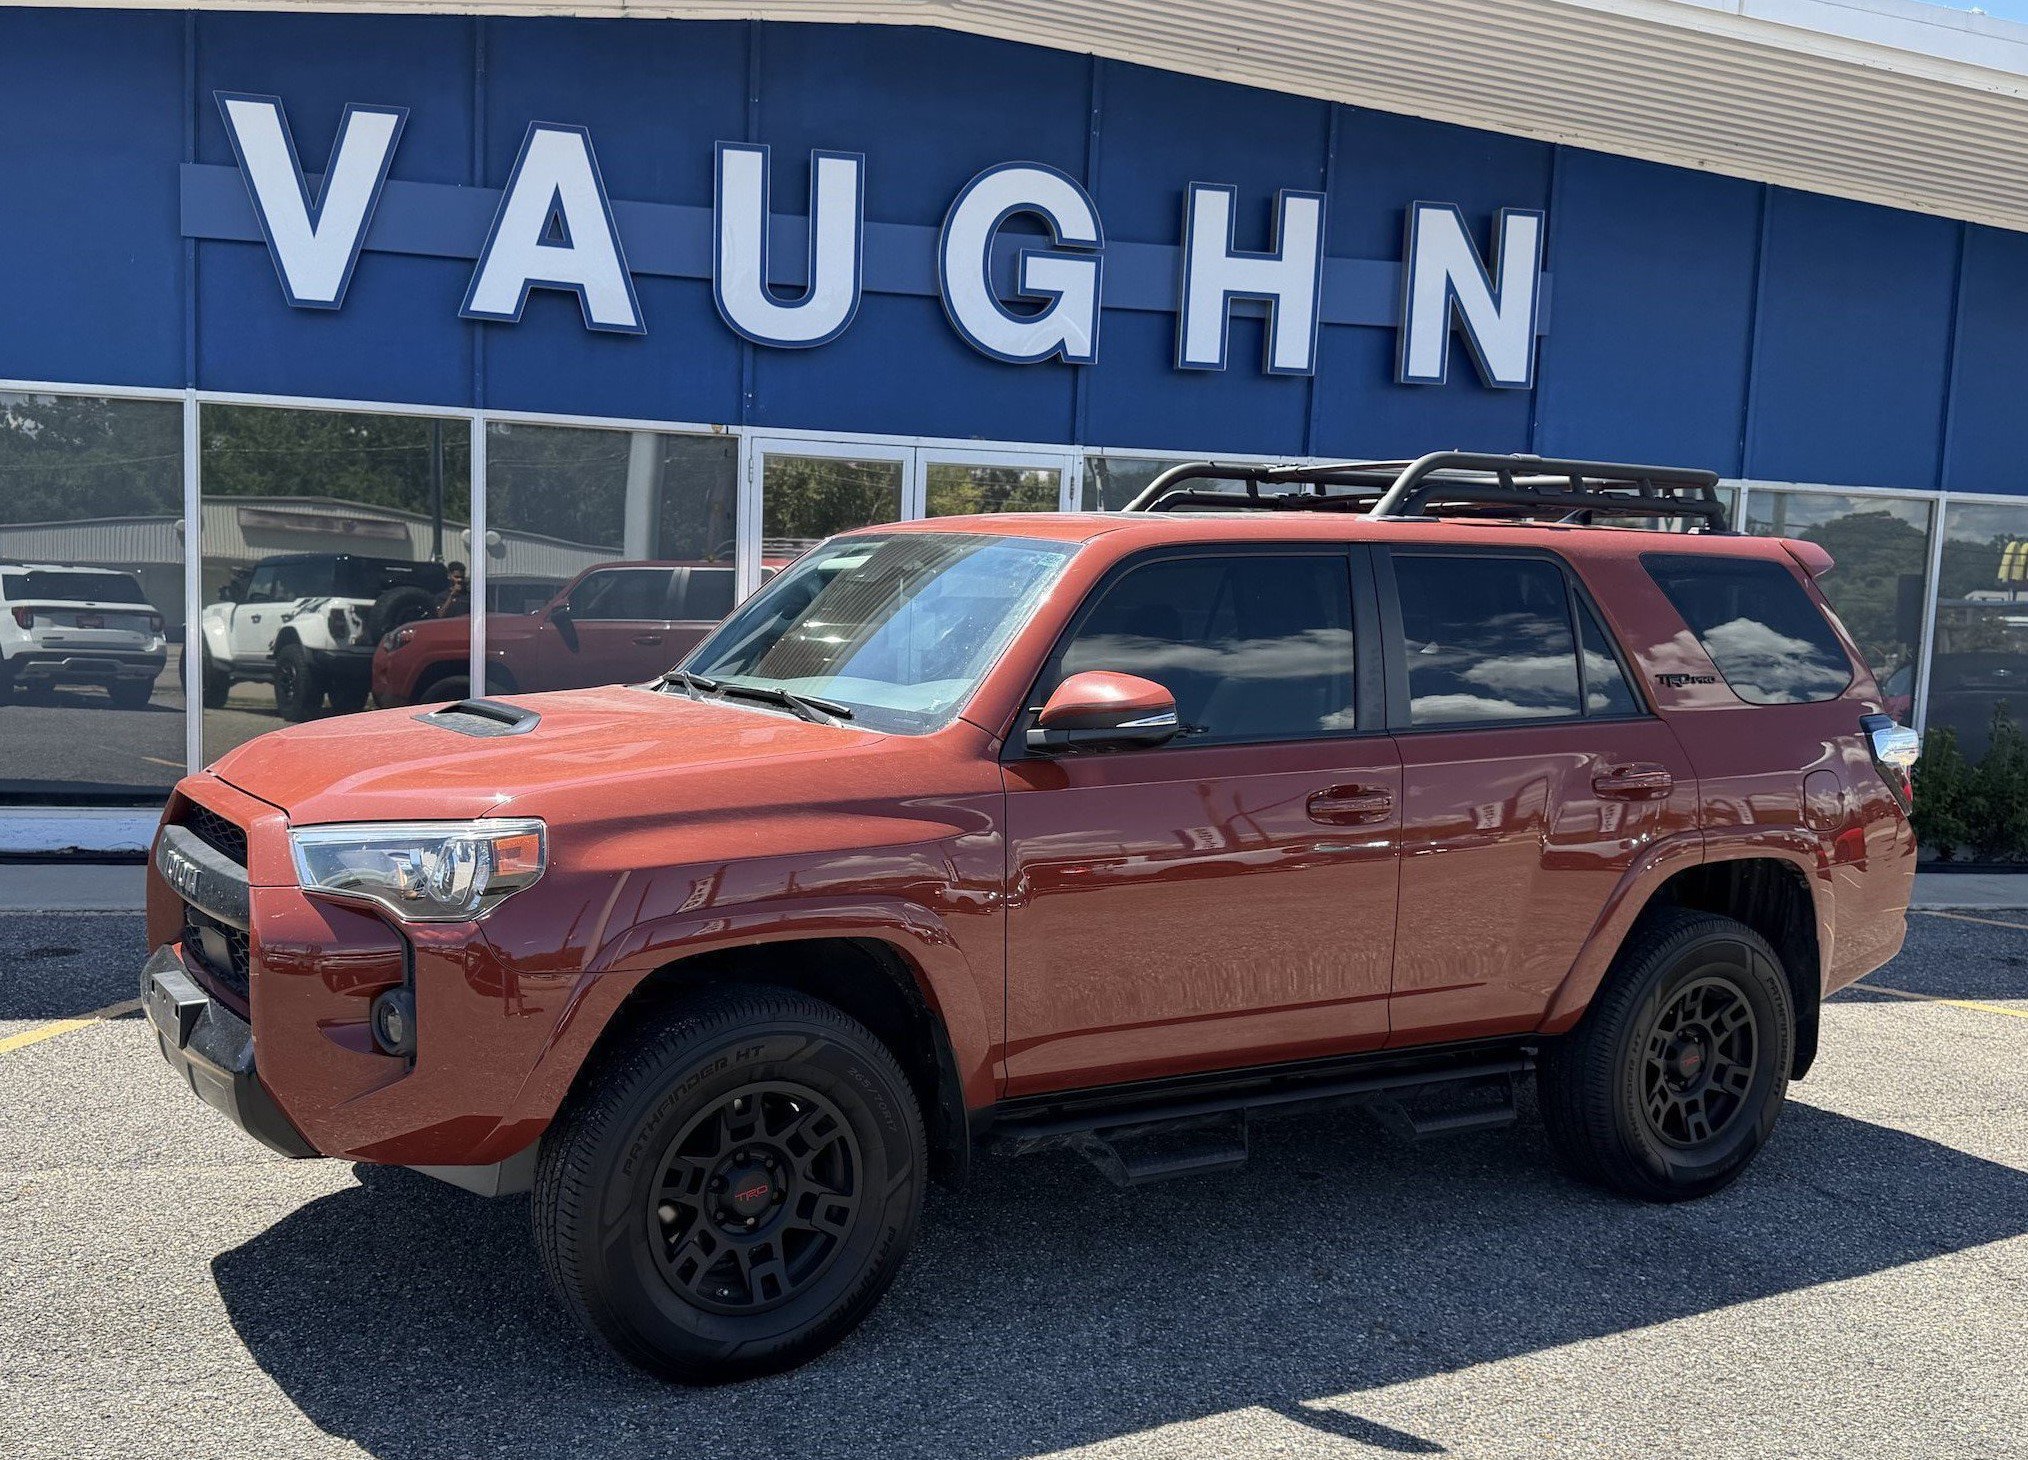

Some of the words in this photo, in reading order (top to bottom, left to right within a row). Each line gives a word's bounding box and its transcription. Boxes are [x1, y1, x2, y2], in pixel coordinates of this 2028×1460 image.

[213, 90, 1546, 390] VAUGHN
[1655, 673, 1690, 687] TRD
[622, 1056, 729, 1176] PATHFINDER
[736, 1044, 766, 1063] HT
[735, 1184, 768, 1202] TRD
